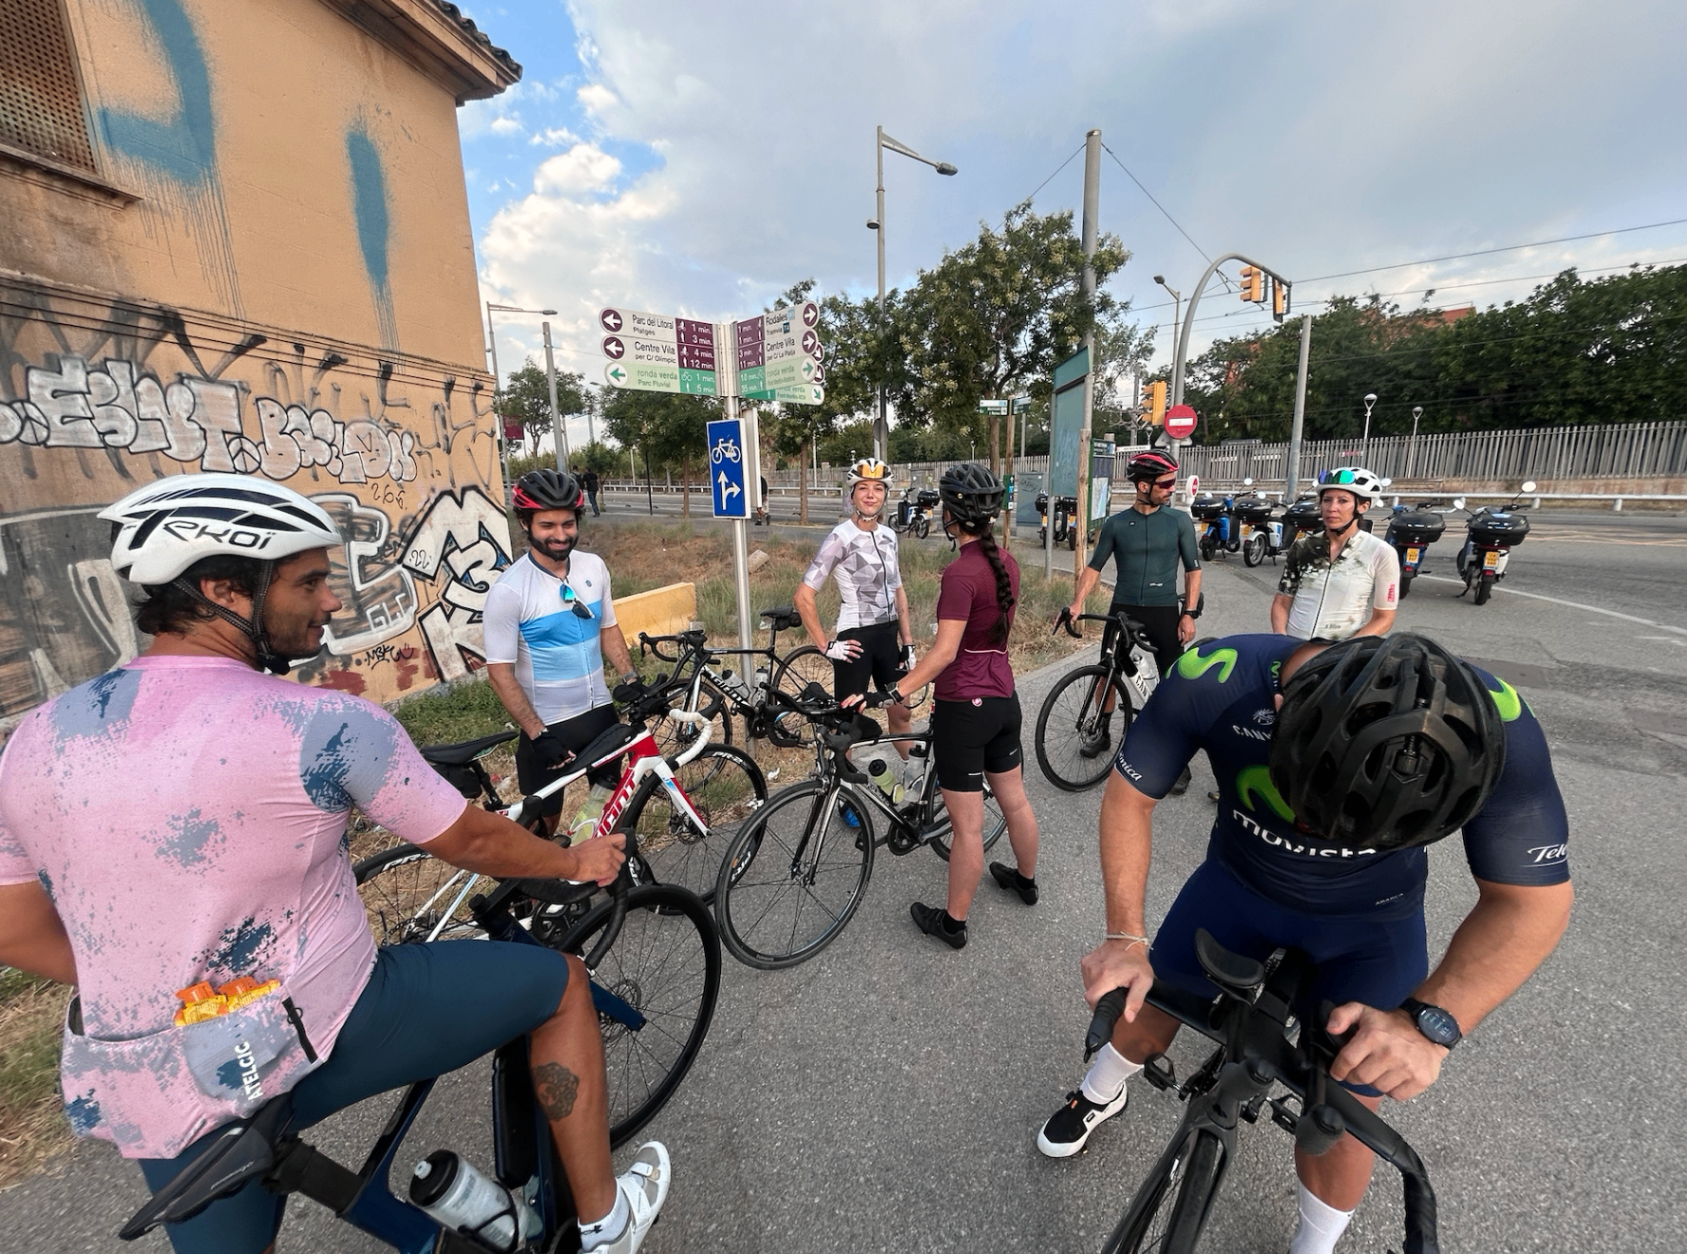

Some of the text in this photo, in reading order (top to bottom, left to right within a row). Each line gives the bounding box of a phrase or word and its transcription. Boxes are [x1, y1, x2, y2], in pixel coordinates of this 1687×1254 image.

[632, 314, 674, 331] Parc del Litoral
[766, 313, 787, 325] Rodalies
[633, 327, 655, 336] Platges
[692, 323, 696, 331] 1
[692, 335, 698, 343] 3
[634, 341, 675, 354] Centre Vila
[766, 337, 796, 352] Centre Vila
[739, 349, 744, 358] 3
[690, 359, 700, 368] 12
[740, 361, 747, 369] 11
[637, 370, 678, 381] ronda verda
[638, 379, 671, 388] Parc Fluvial
[596, 769, 637, 837] IANT
